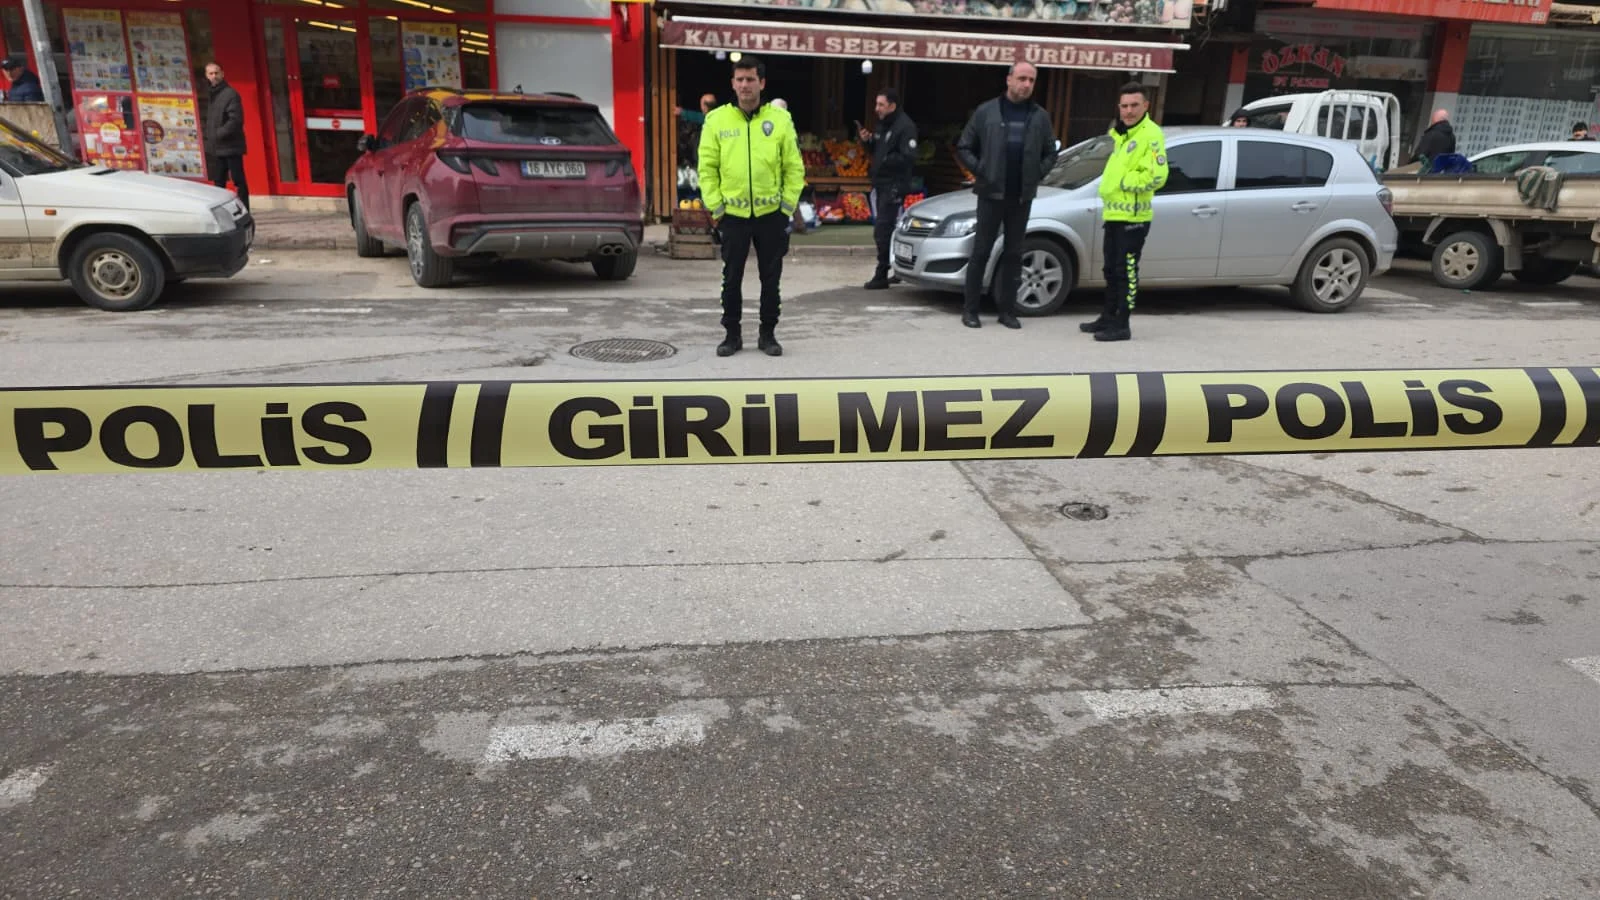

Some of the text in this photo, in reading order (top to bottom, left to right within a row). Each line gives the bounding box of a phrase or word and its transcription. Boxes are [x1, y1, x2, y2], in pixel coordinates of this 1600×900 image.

[684, 28, 1152, 68] KALİTELİ SEBZE MEYVE ÜRÜNLERİ
[13, 379, 1503, 471] POLİS GİRİLMEZ POLİS
